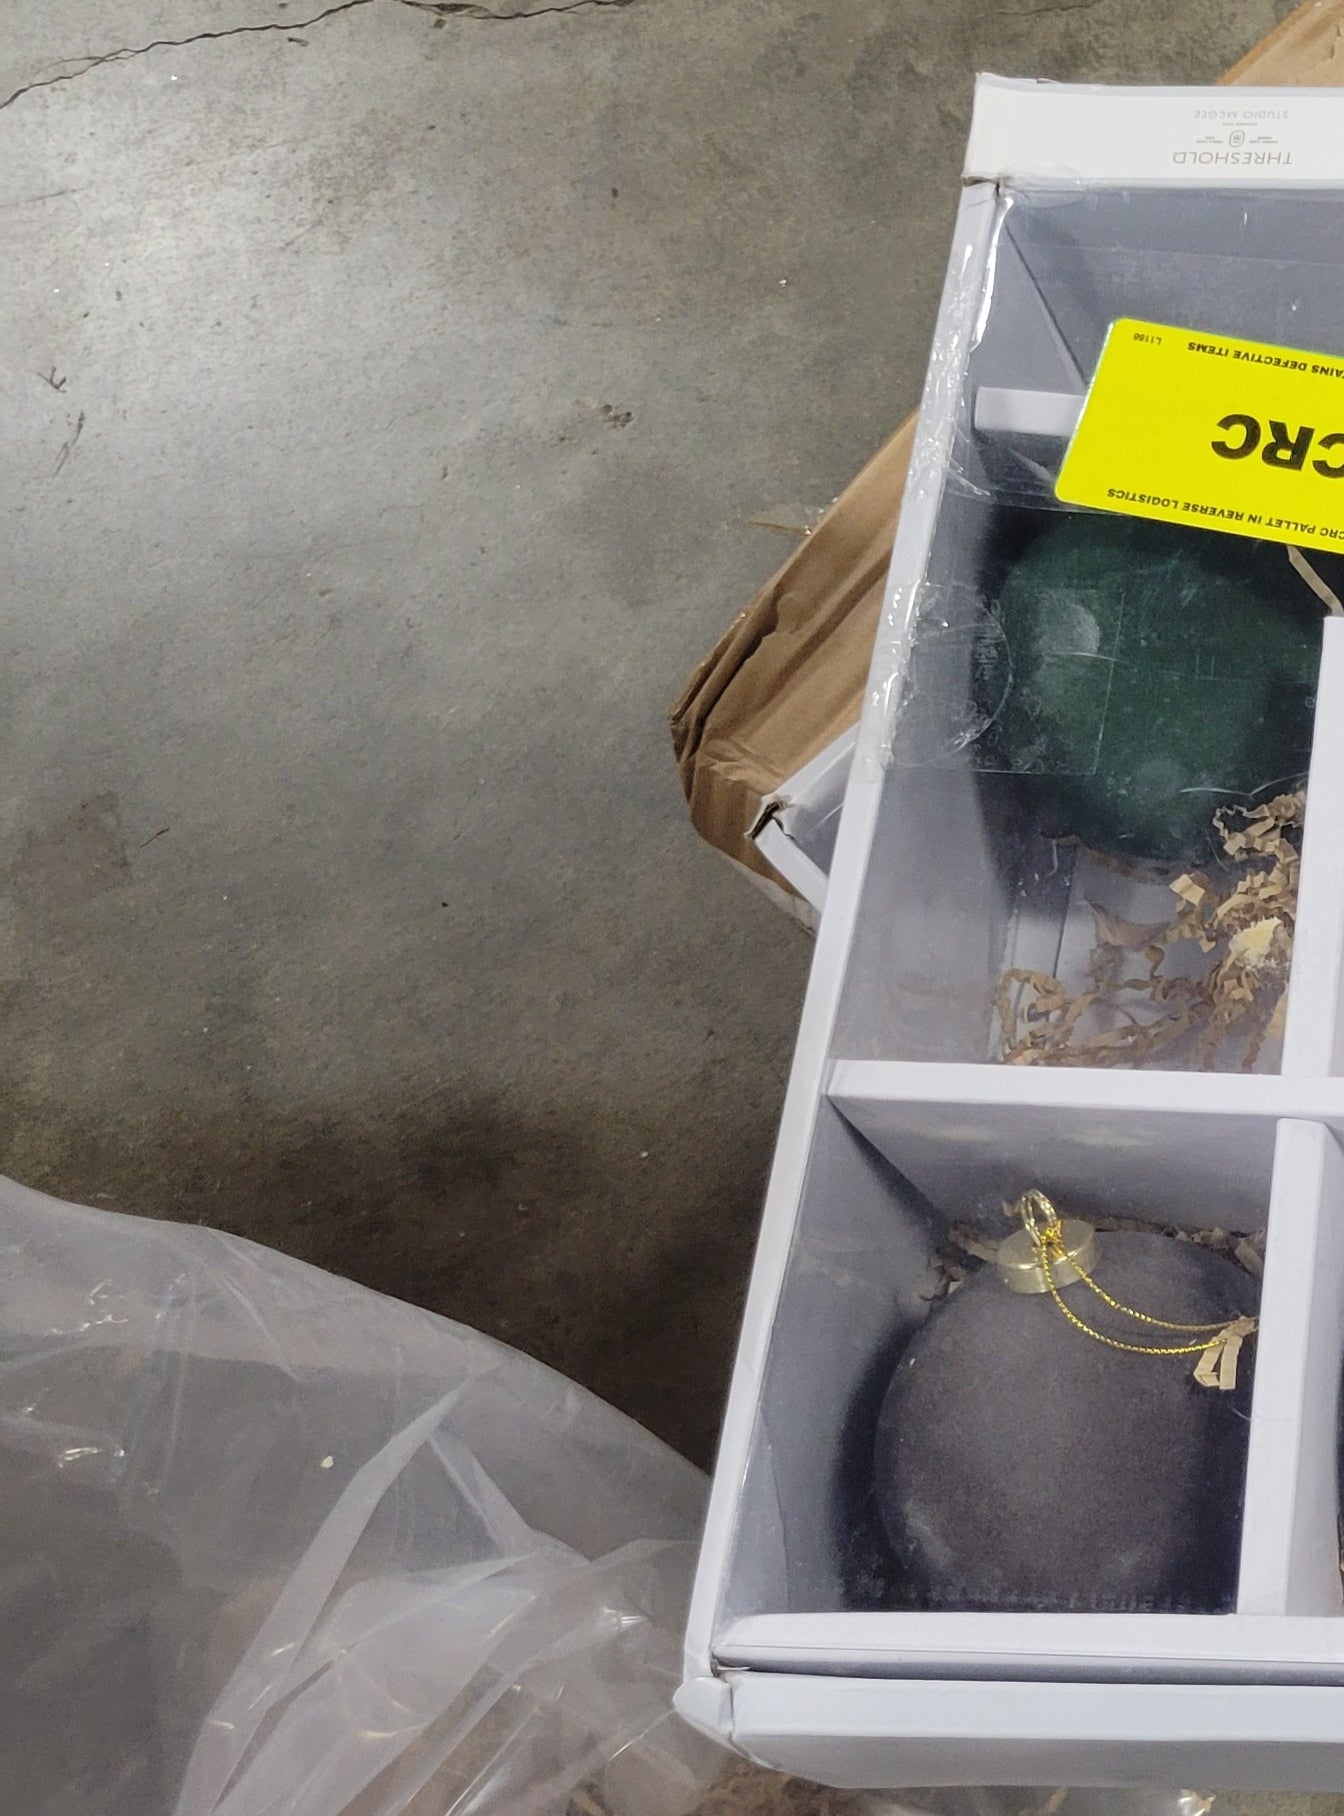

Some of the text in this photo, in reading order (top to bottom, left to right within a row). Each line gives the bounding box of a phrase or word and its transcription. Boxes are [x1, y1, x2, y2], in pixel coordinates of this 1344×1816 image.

[1242, 110, 1289, 120] STUDIO
[1172, 151, 1293, 165] THRESHOLD
[1187, 342, 1229, 357] ITEMS
[1233, 349, 1306, 371] DEFECTIVE
[1106, 489, 1178, 511] LOGISTICS
[1182, 503, 1243, 522] REVERSE
[1247, 514, 1262, 525] IN
[1265, 518, 1316, 535] PALLET
